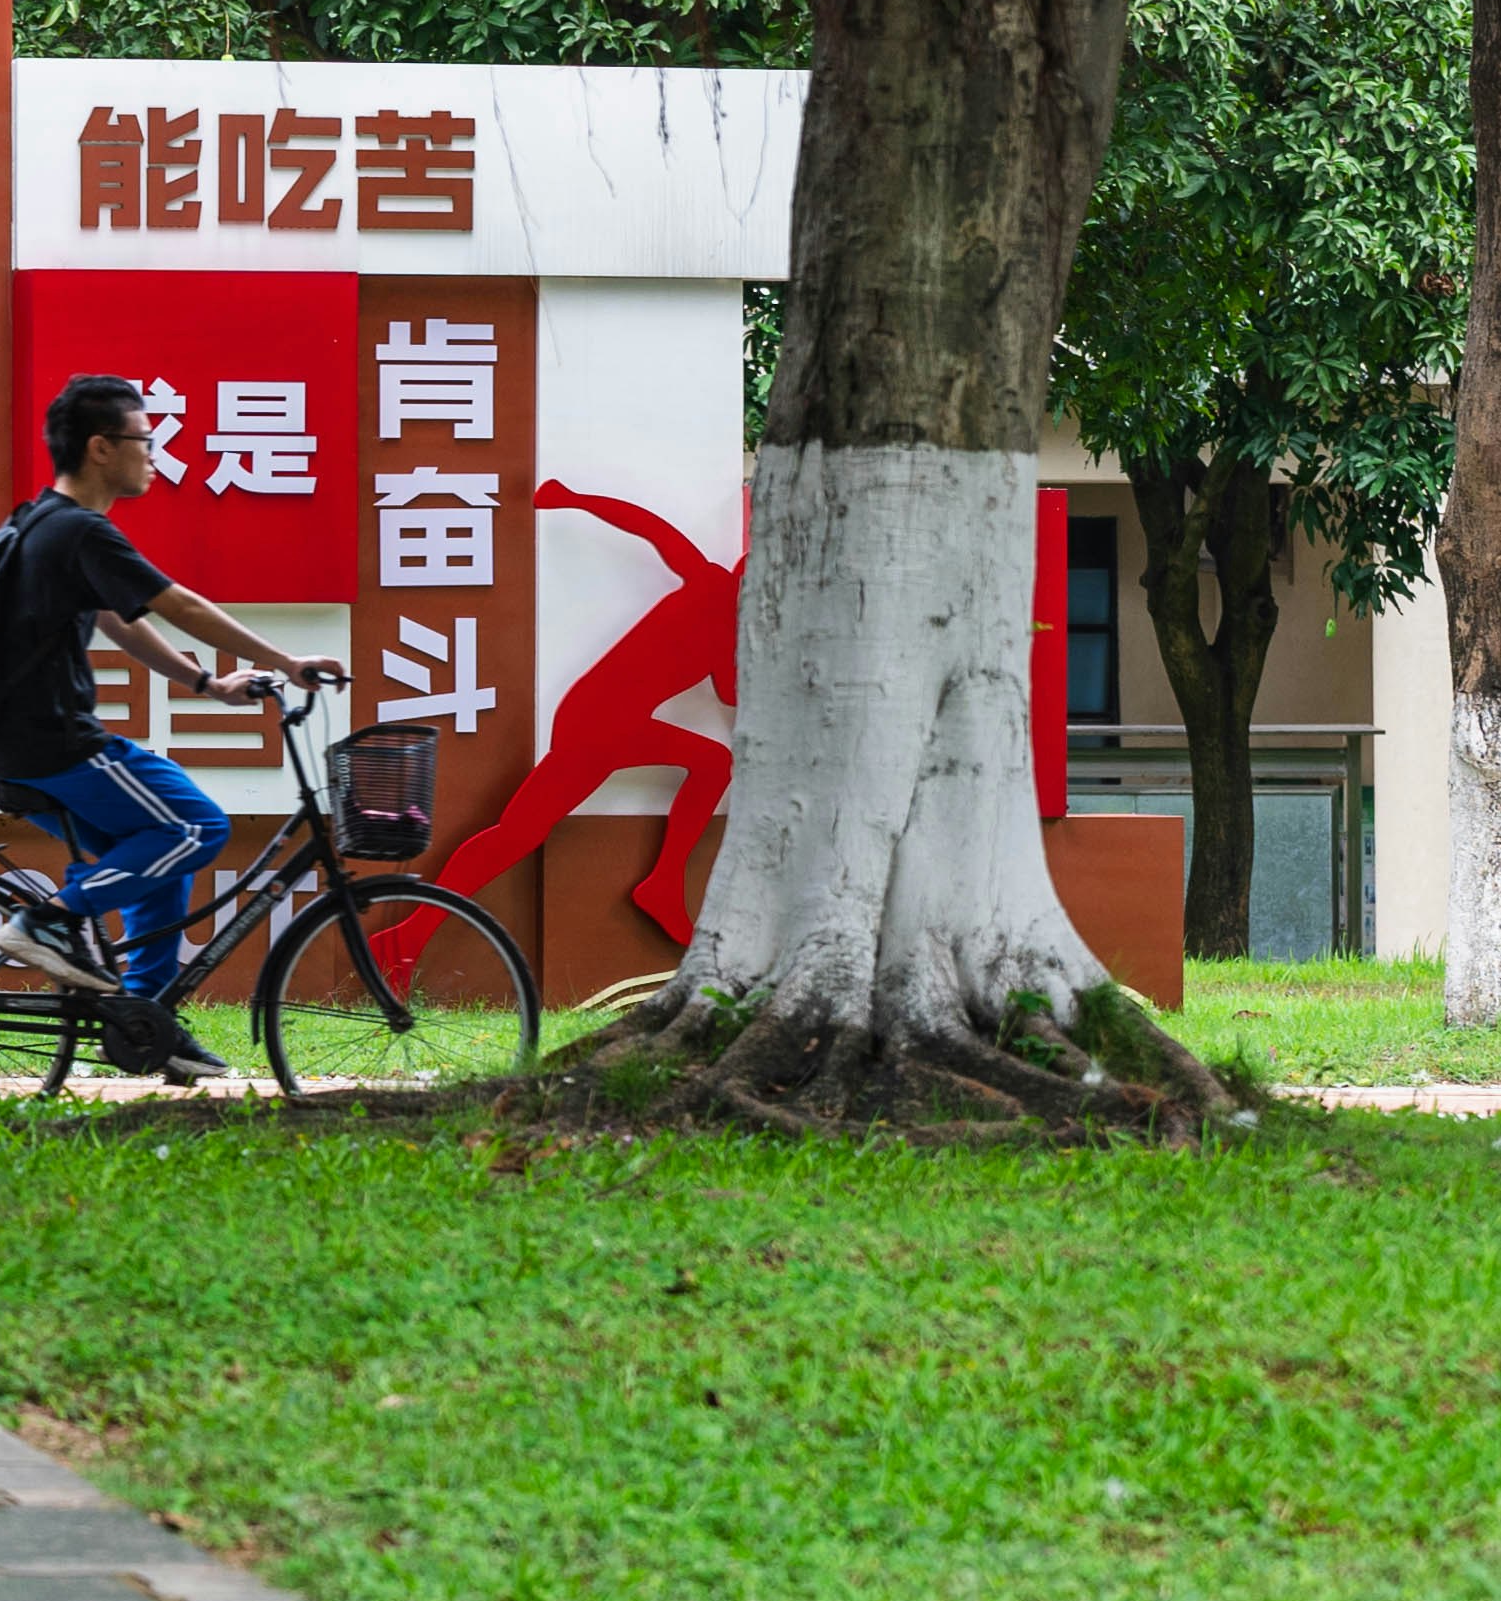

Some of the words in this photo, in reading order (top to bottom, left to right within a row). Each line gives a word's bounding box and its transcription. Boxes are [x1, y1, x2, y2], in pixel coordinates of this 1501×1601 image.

[78, 106, 476, 232] 能吃苦
[373, 318, 501, 734] 肯奋斗
